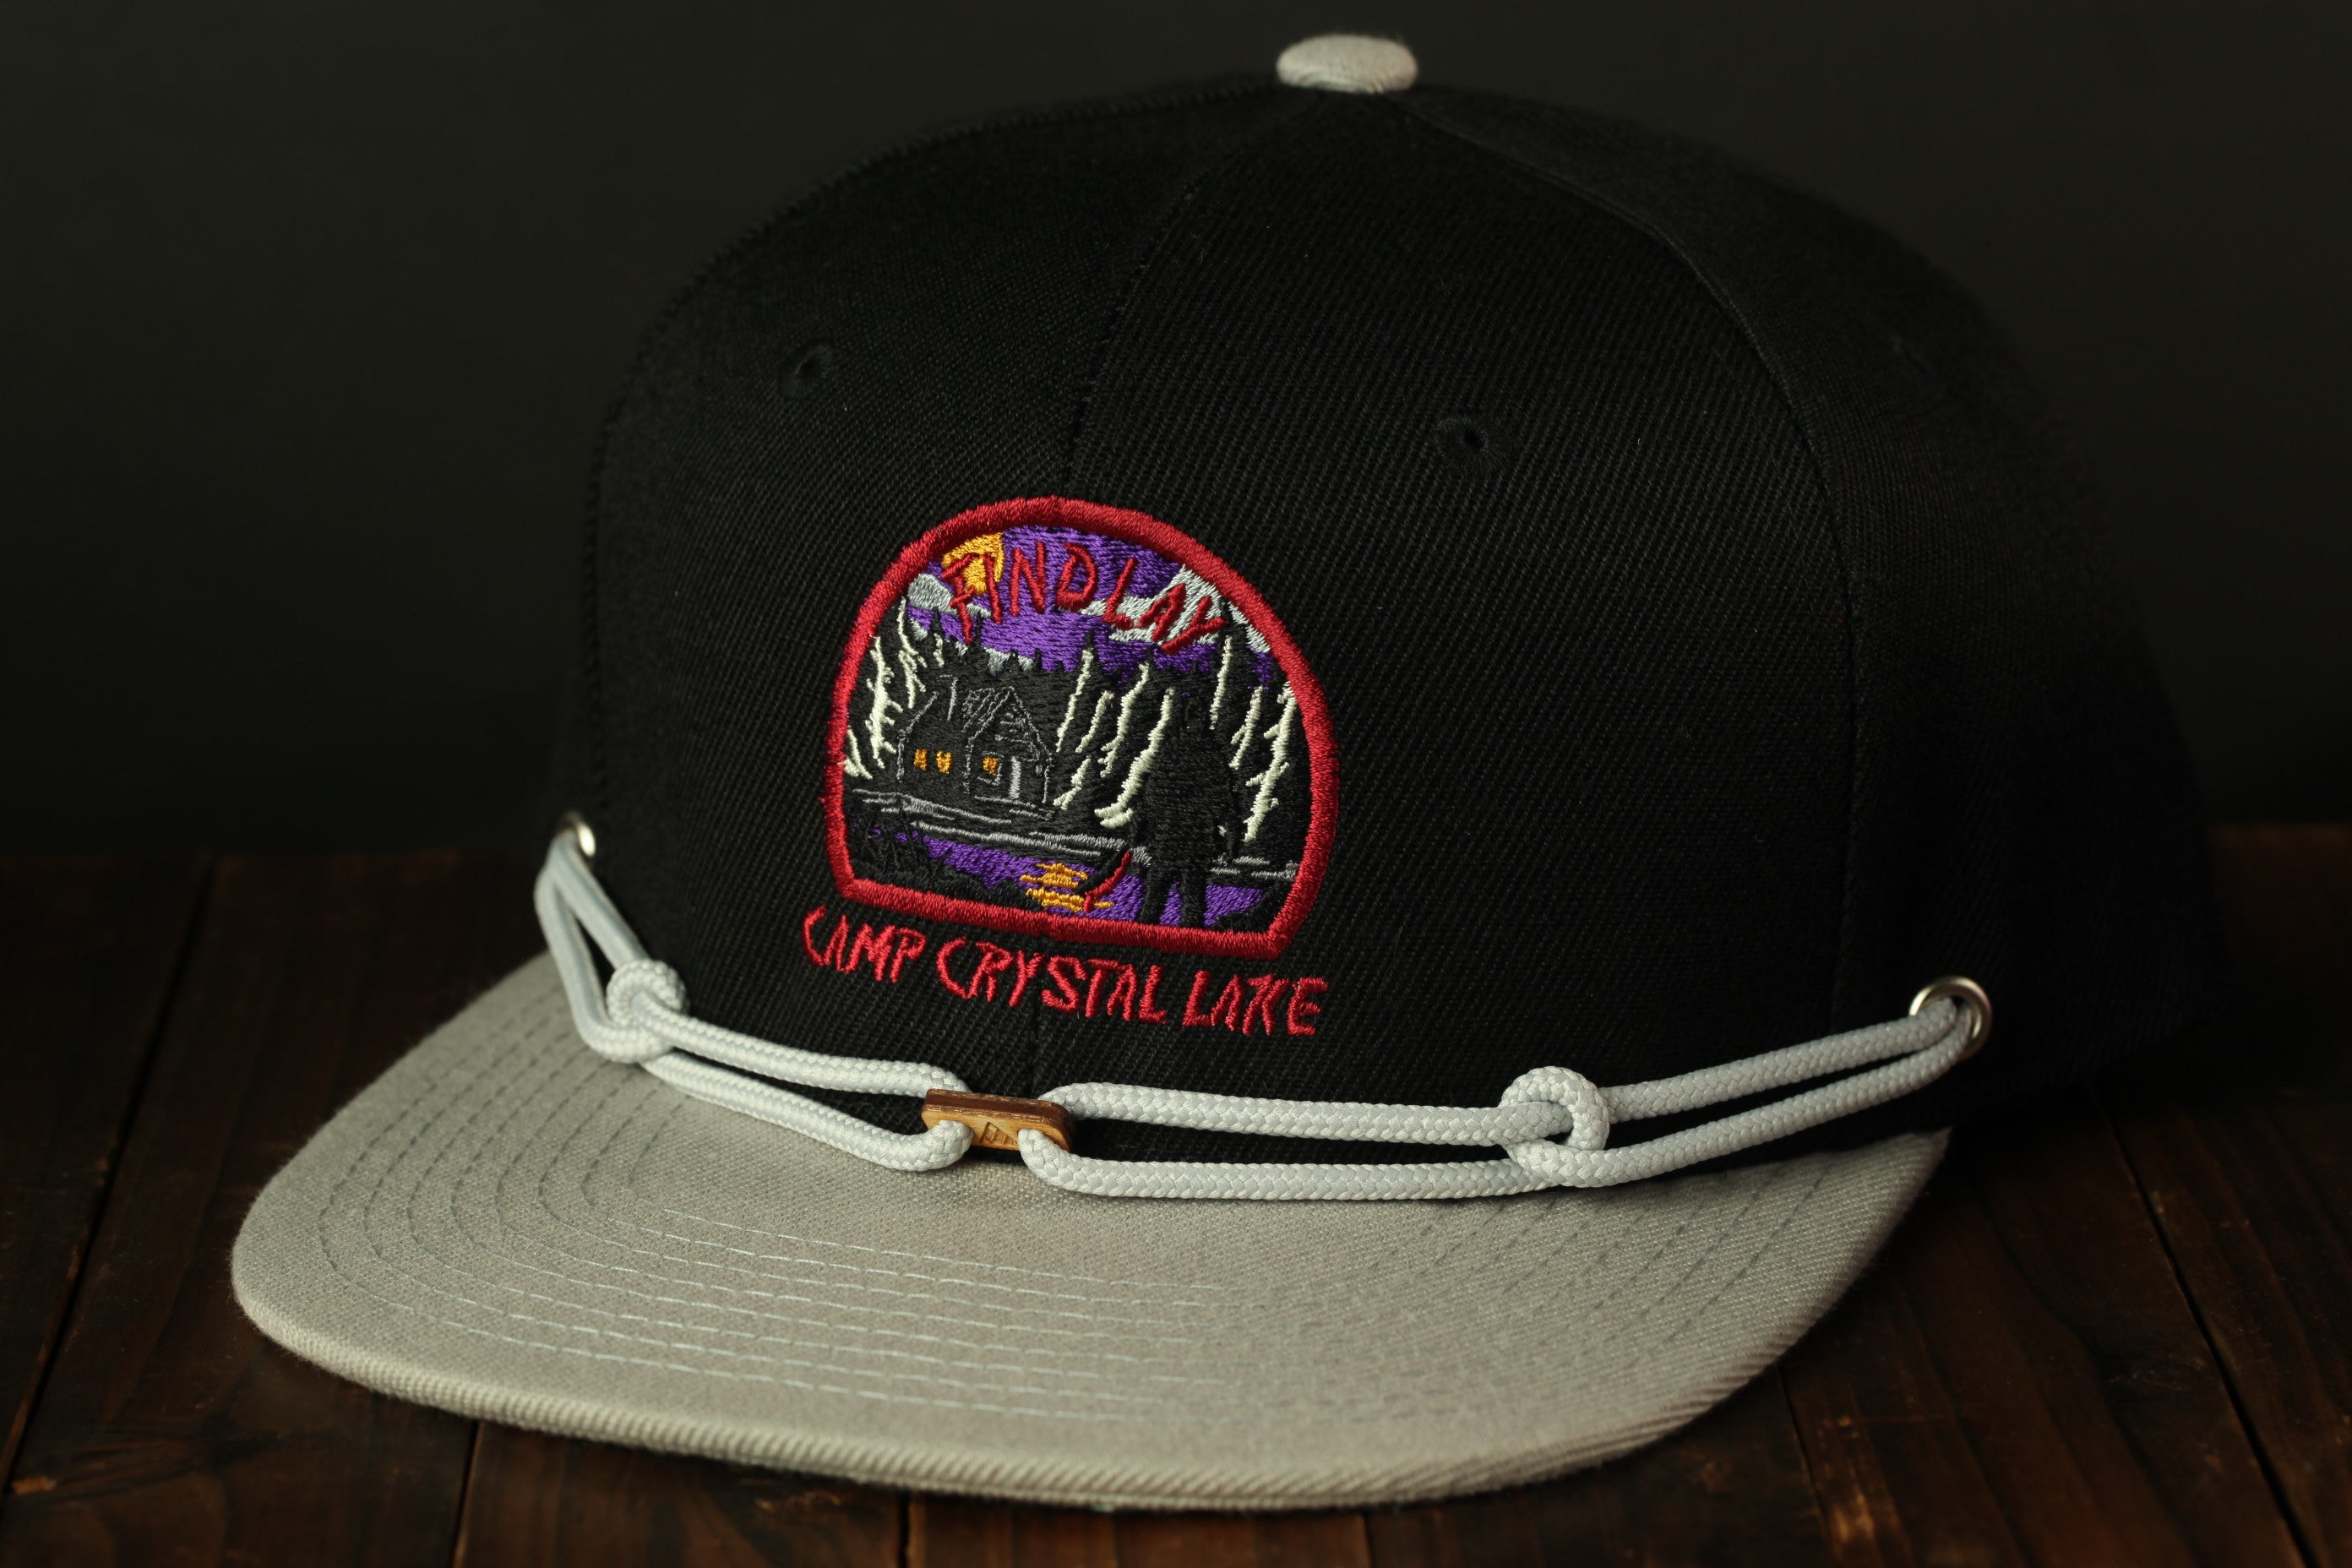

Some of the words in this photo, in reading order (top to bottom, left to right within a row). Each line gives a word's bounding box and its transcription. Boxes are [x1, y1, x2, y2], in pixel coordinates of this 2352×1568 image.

[942, 542, 1228, 655] FINDLAY
[803, 905, 926, 983] CAMP
[936, 936, 1167, 1025] CRYSTAL
[1183, 970, 1329, 1037] LAKE
